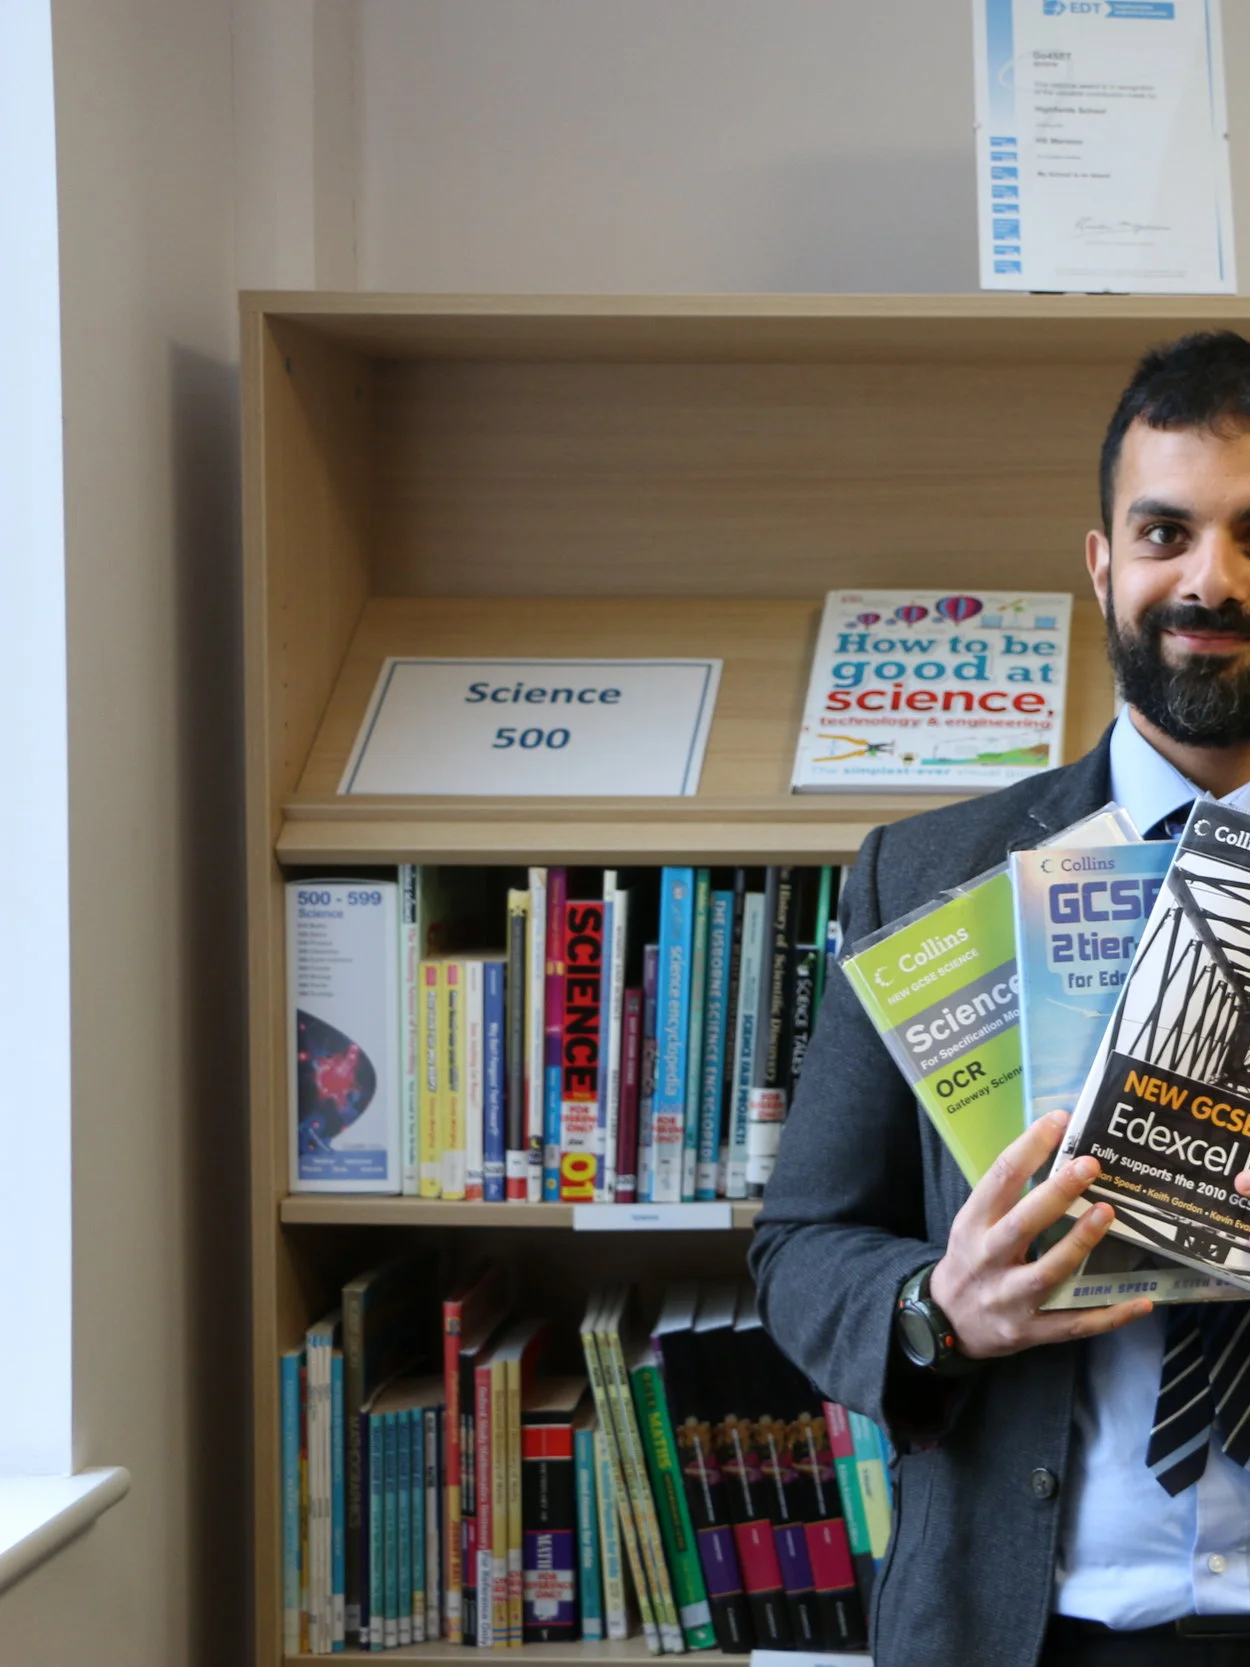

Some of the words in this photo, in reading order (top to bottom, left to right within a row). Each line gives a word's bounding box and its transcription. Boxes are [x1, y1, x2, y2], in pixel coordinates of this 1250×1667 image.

[1070, 2, 1101, 14] EDT
[834, 632, 935, 655] How
[949, 635, 988, 655] to
[1002, 635, 1056, 657] be
[832, 655, 989, 688] good
[1007, 662, 1053, 684] at
[464, 682, 623, 705] Science
[825, 683, 1055, 717] science,
[492, 727, 571, 750] 500
[820, 715, 924, 728] technology
[927, 716, 939, 727] &
[843, 766, 952, 777] simplest-ever
[1060, 856, 1116, 873] Collins
[297, 891, 331, 906] 500
[347, 890, 383, 906] 599
[297, 908, 344, 919] Science
[712, 900, 727, 925] THE
[775, 933, 789, 949] of
[898, 925, 970, 974] Collins
[668, 944, 687, 998] science
[709, 929, 726, 998] USBORNE
[887, 987, 911, 1007] NEW
[911, 973, 939, 993] GCSE
[937, 948, 981, 977] SCIENCE
[1068, 972, 1094, 988] for
[564, 906, 602, 1091] SCIENCE
[794, 978, 813, 1028] SCIENCE
[905, 971, 1019, 1053] Science
[662, 998, 684, 1098] encyclopedia
[706, 1002, 720, 1062] SCIENCE
[740, 1013, 754, 1059] SCIENCE
[921, 1054, 940, 1071] For
[938, 1017, 1004, 1061] Specification
[738, 1061, 751, 1087] FAIR
[935, 1060, 987, 1099] OCR
[1123, 1069, 1190, 1110] NEW
[734, 1087, 749, 1146] PROJECTS
[946, 1085, 991, 1115] Gateway
[1106, 1100, 1240, 1176] Edexcel
[1090, 1142, 1121, 1166] Fully
[1119, 1156, 1173, 1184] supports
[1173, 1173, 1195, 1191] the
[1195, 1181, 1227, 1203] 2010
[1113, 1175, 1142, 1194] Speed
[1146, 1187, 1171, 1203] Keith
[1170, 1195, 1204, 1216] Gordon
[1208, 1210, 1235, 1226] Kevin
[1072, 1284, 1113, 1298] BRIAN
[1116, 1281, 1159, 1293] SPEED
[647, 1411, 673, 1470] MATHS
[481, 1552, 491, 1570] For
[481, 1571, 491, 1621] Reference
[479, 1622, 491, 1646] Only
